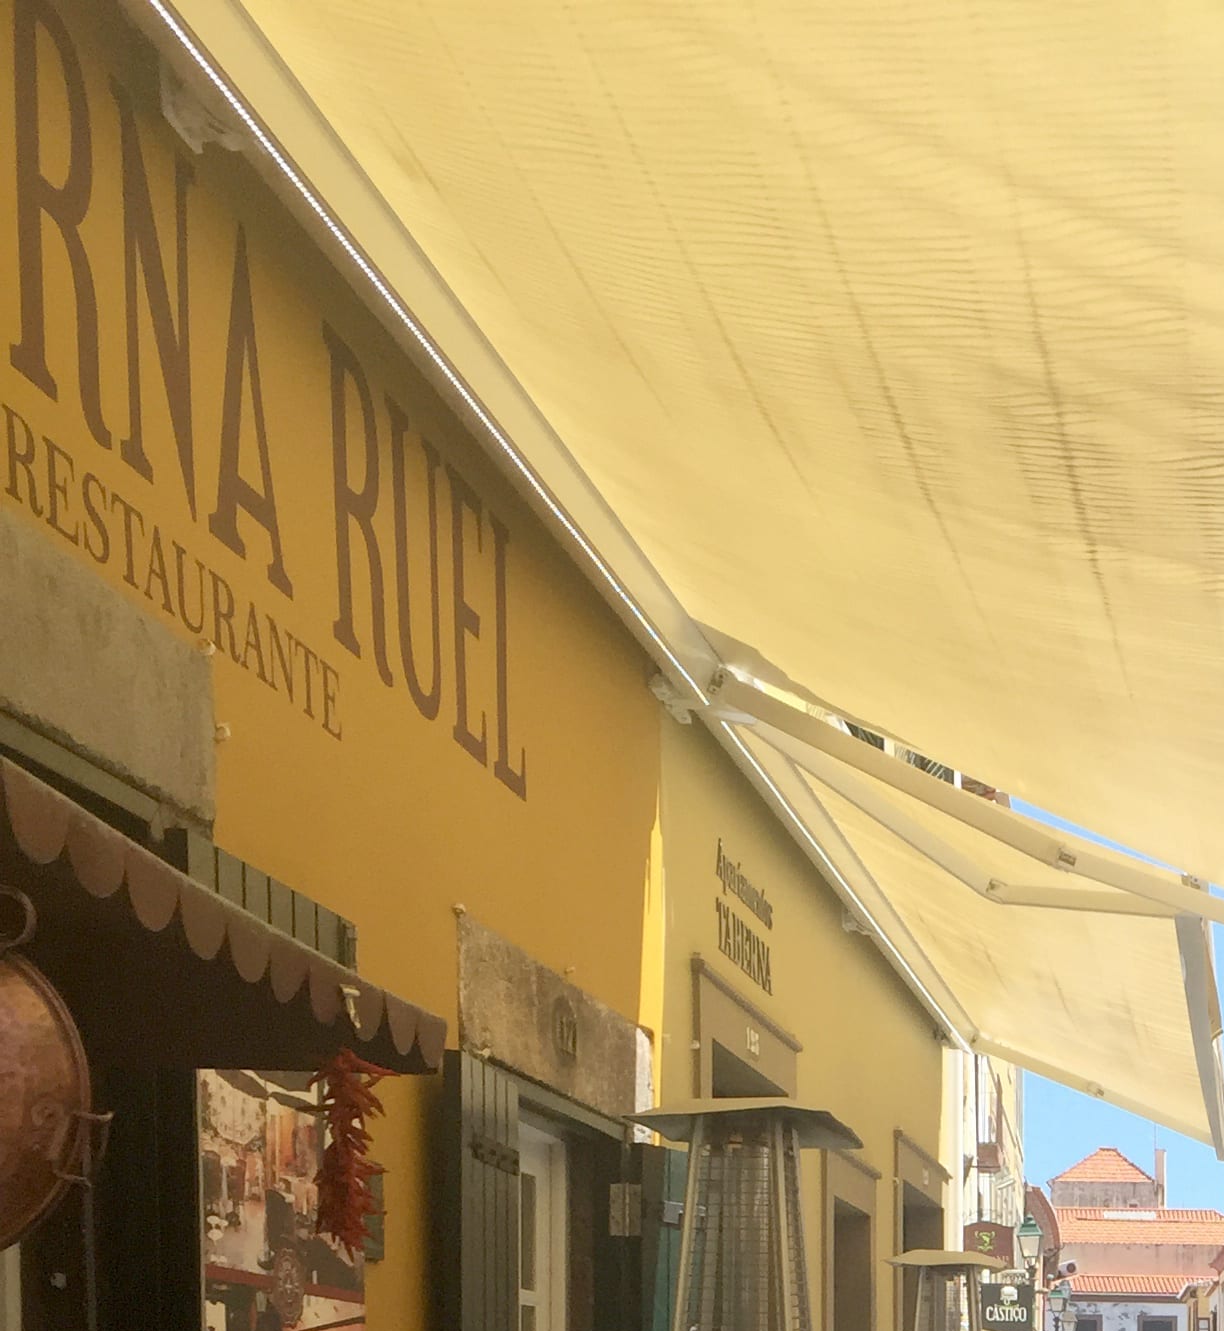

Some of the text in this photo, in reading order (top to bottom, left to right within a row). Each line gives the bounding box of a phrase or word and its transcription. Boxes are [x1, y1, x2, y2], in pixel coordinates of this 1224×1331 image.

[9, 0, 528, 802] RNA RUEL
[4, 407, 343, 742] RESTAURANTE
[715, 896, 774, 997] TABERNA
[985, 1306, 1027, 1322] CASTIÇO
